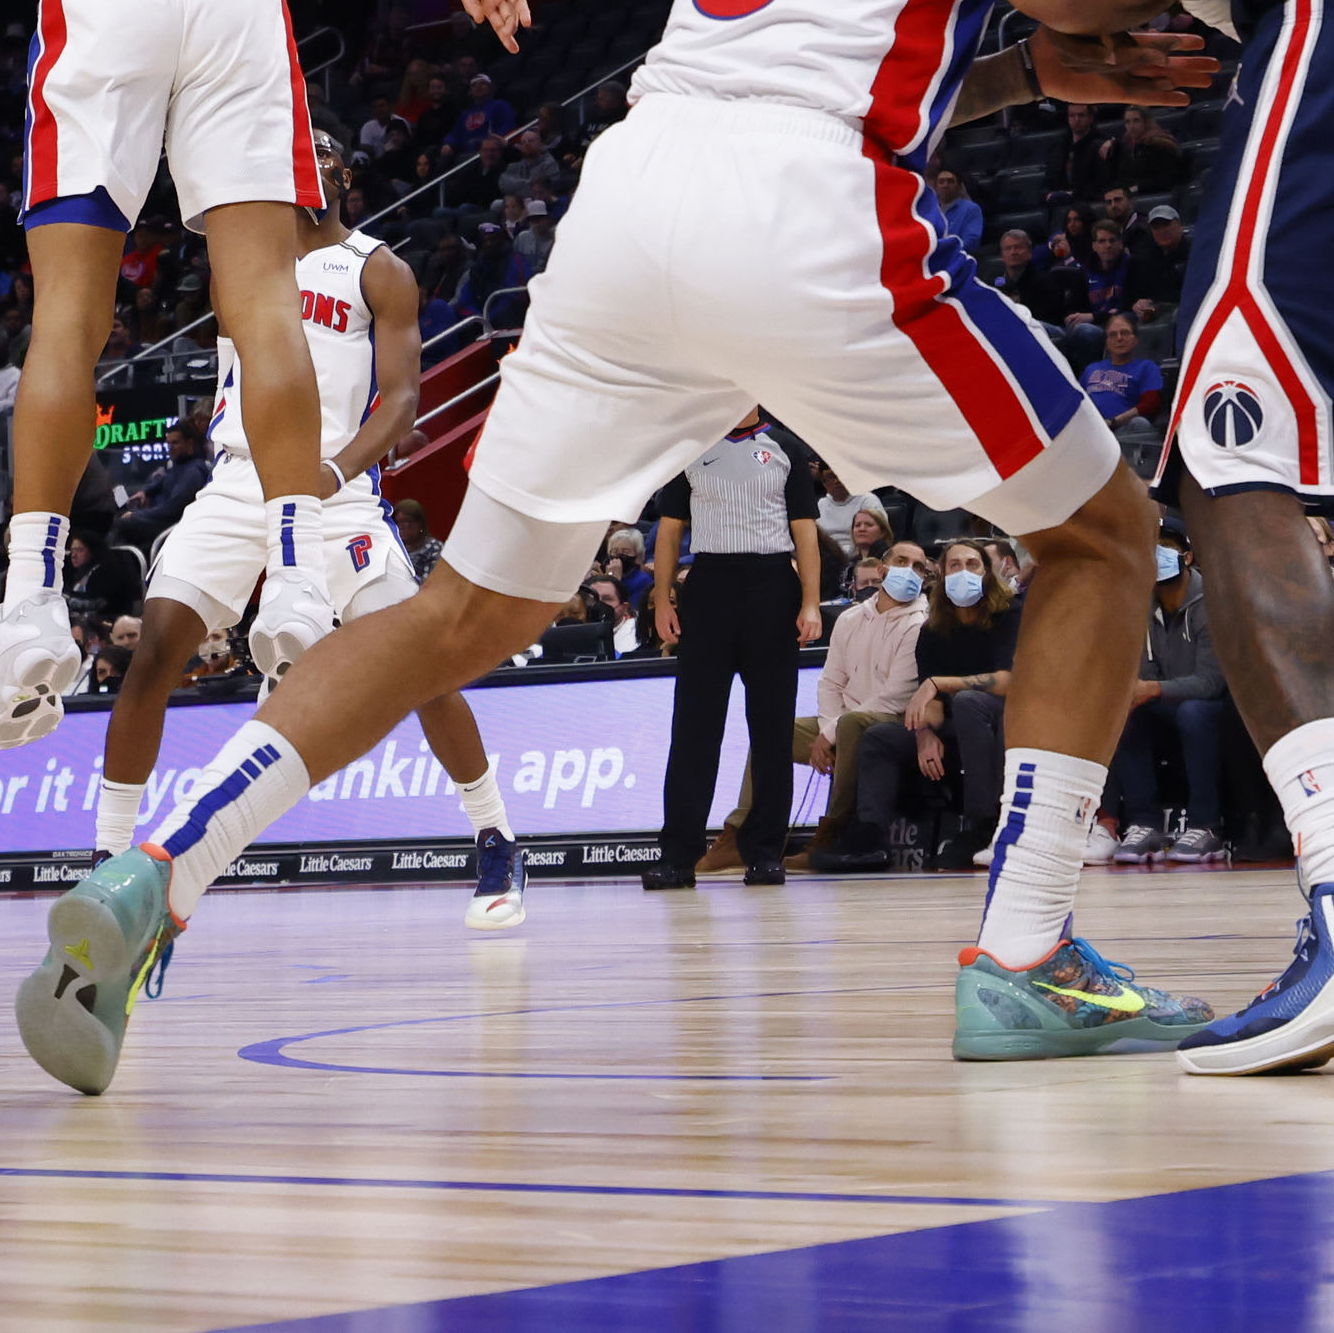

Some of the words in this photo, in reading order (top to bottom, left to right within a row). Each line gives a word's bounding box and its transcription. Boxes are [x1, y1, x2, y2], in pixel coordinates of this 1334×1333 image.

[323, 262, 349, 272] UWM
[35, 757, 75, 813] it
[513, 747, 636, 809] app.
[392, 852, 422, 869] Little
[422, 850, 467, 868] Caesars
[520, 848, 565, 866] Caesars
[582, 846, 615, 863] Little
[615, 844, 662, 862] Caesars
[236, 859, 278, 876] Caesars
[299, 856, 329, 873] Little
[329, 854, 372, 872] Caesars
[33, 866, 60, 882] Little
